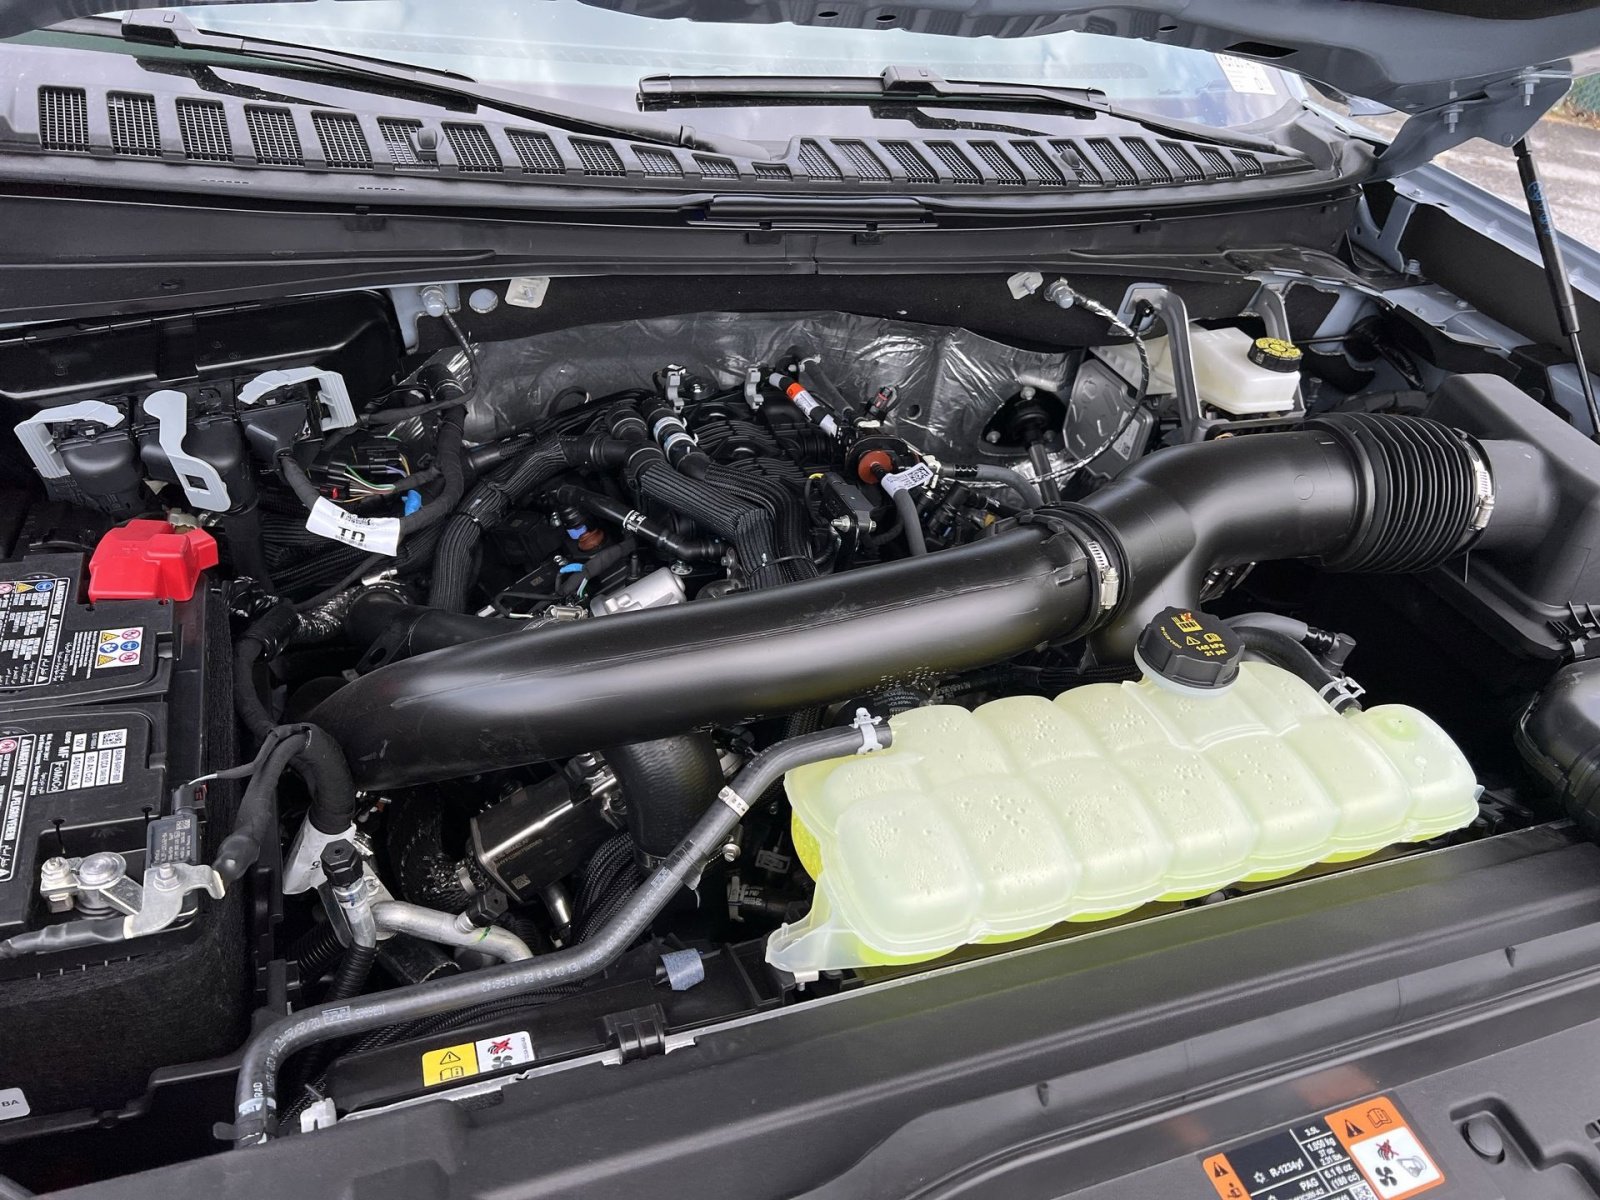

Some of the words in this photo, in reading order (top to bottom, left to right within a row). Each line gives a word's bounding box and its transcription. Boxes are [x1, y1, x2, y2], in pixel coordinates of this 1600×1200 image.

[75, 737, 84, 748] 12V
[58, 745, 70, 759] MF
[14, 743, 30, 786] DANGER/POISON
[51, 762, 65, 791] FoMoCo
[4, 796, 22, 841] PELIGRO/VENENO
[253, 1082, 263, 1098] RAD
[1, 1099, 20, 1107] BA
[1268, 1158, 1305, 1178] R-1234yf
[1342, 1163, 1354, 1173] oz
[1299, 1177, 1320, 1192] PAG
